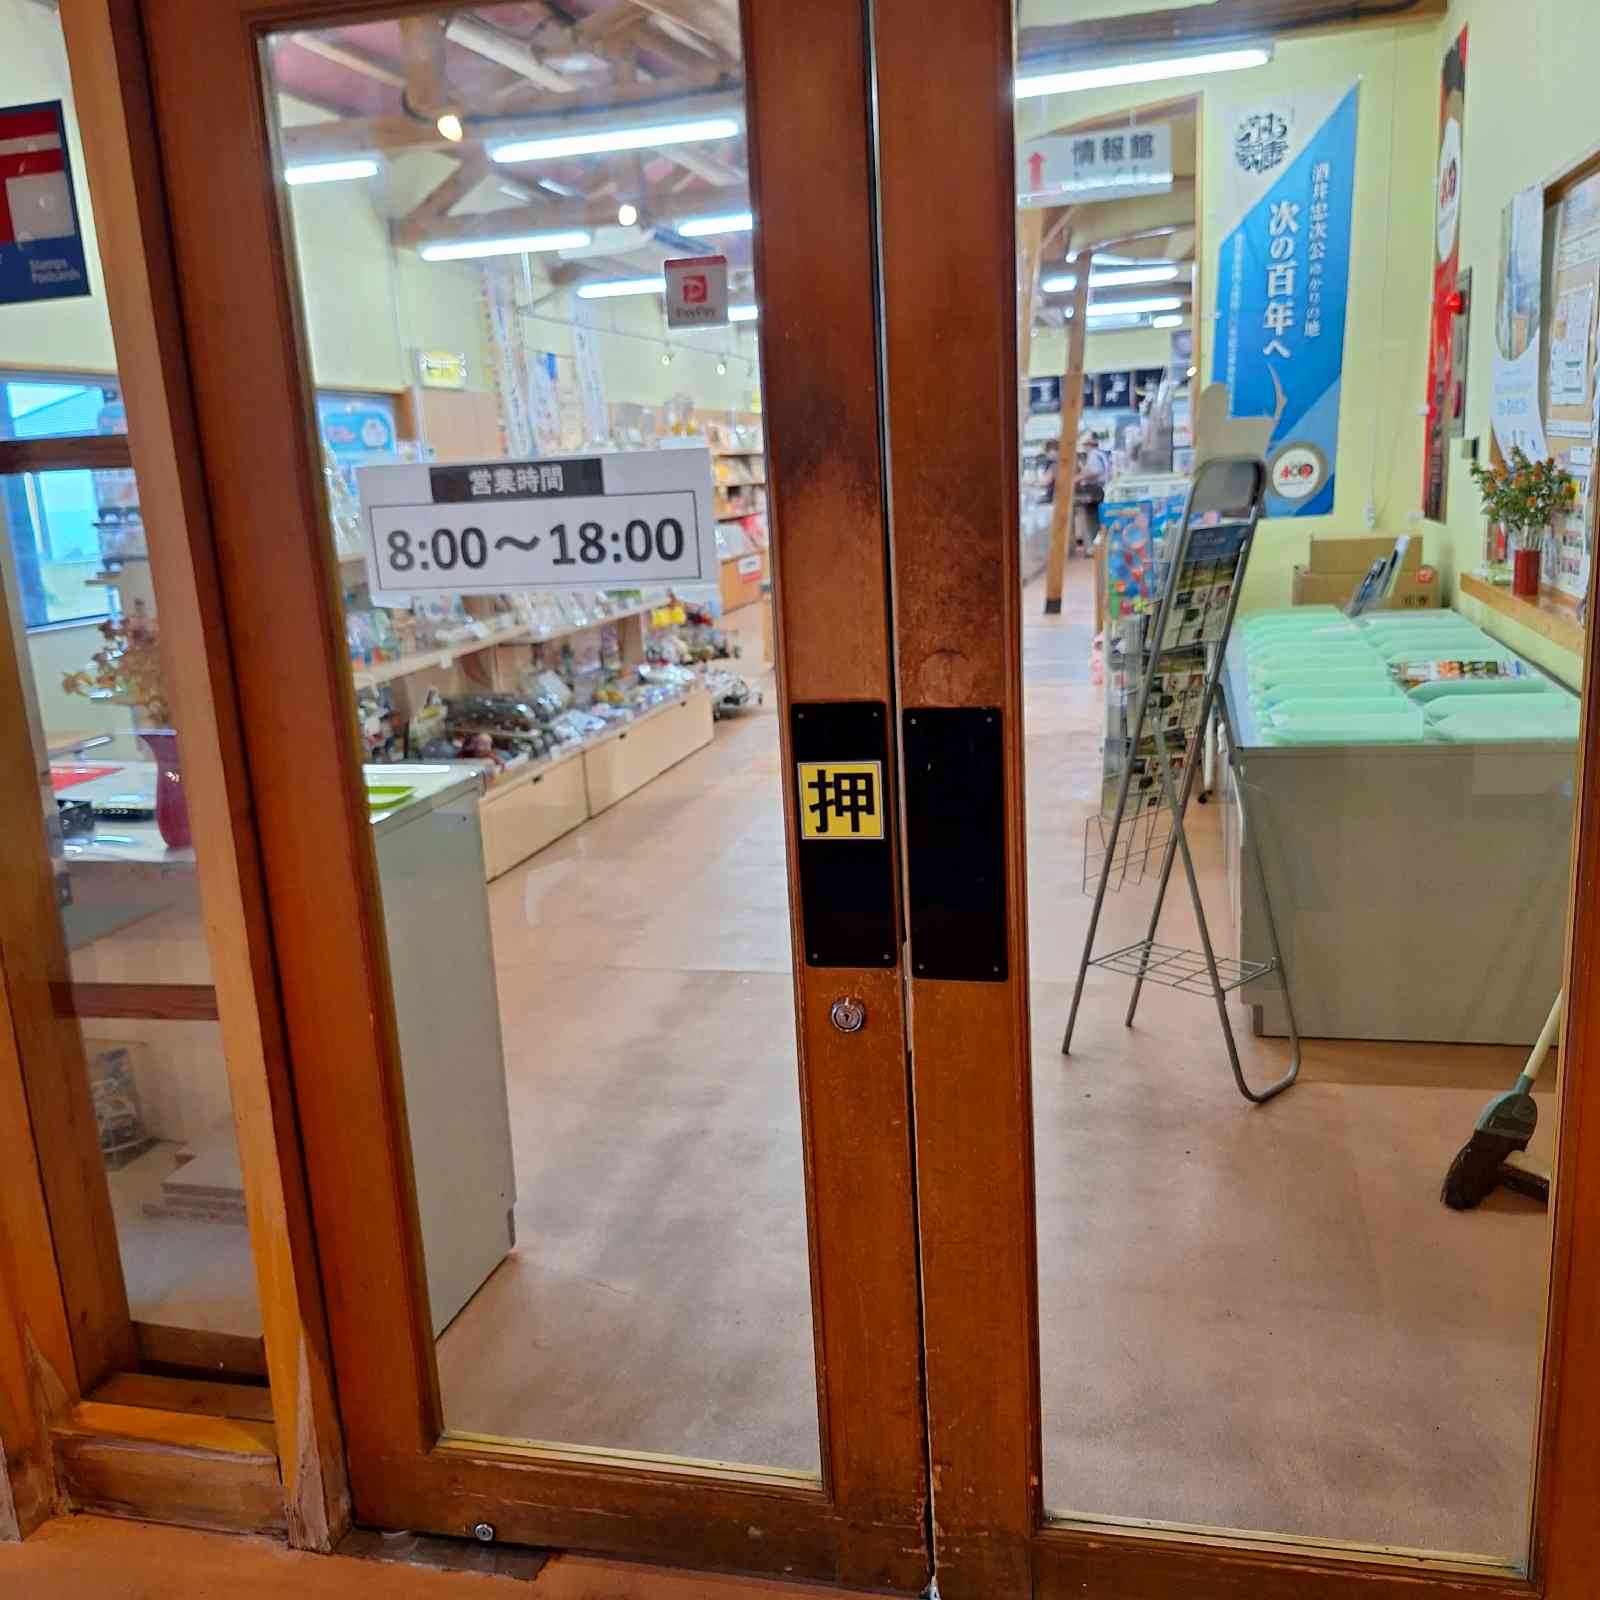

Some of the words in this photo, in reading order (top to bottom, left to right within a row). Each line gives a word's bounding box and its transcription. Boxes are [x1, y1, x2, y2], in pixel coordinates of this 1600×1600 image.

[1262, 200, 1300, 360] 次の百年へ
[469, 465, 564, 496] 営業時間
[809, 769, 875, 833] 押
